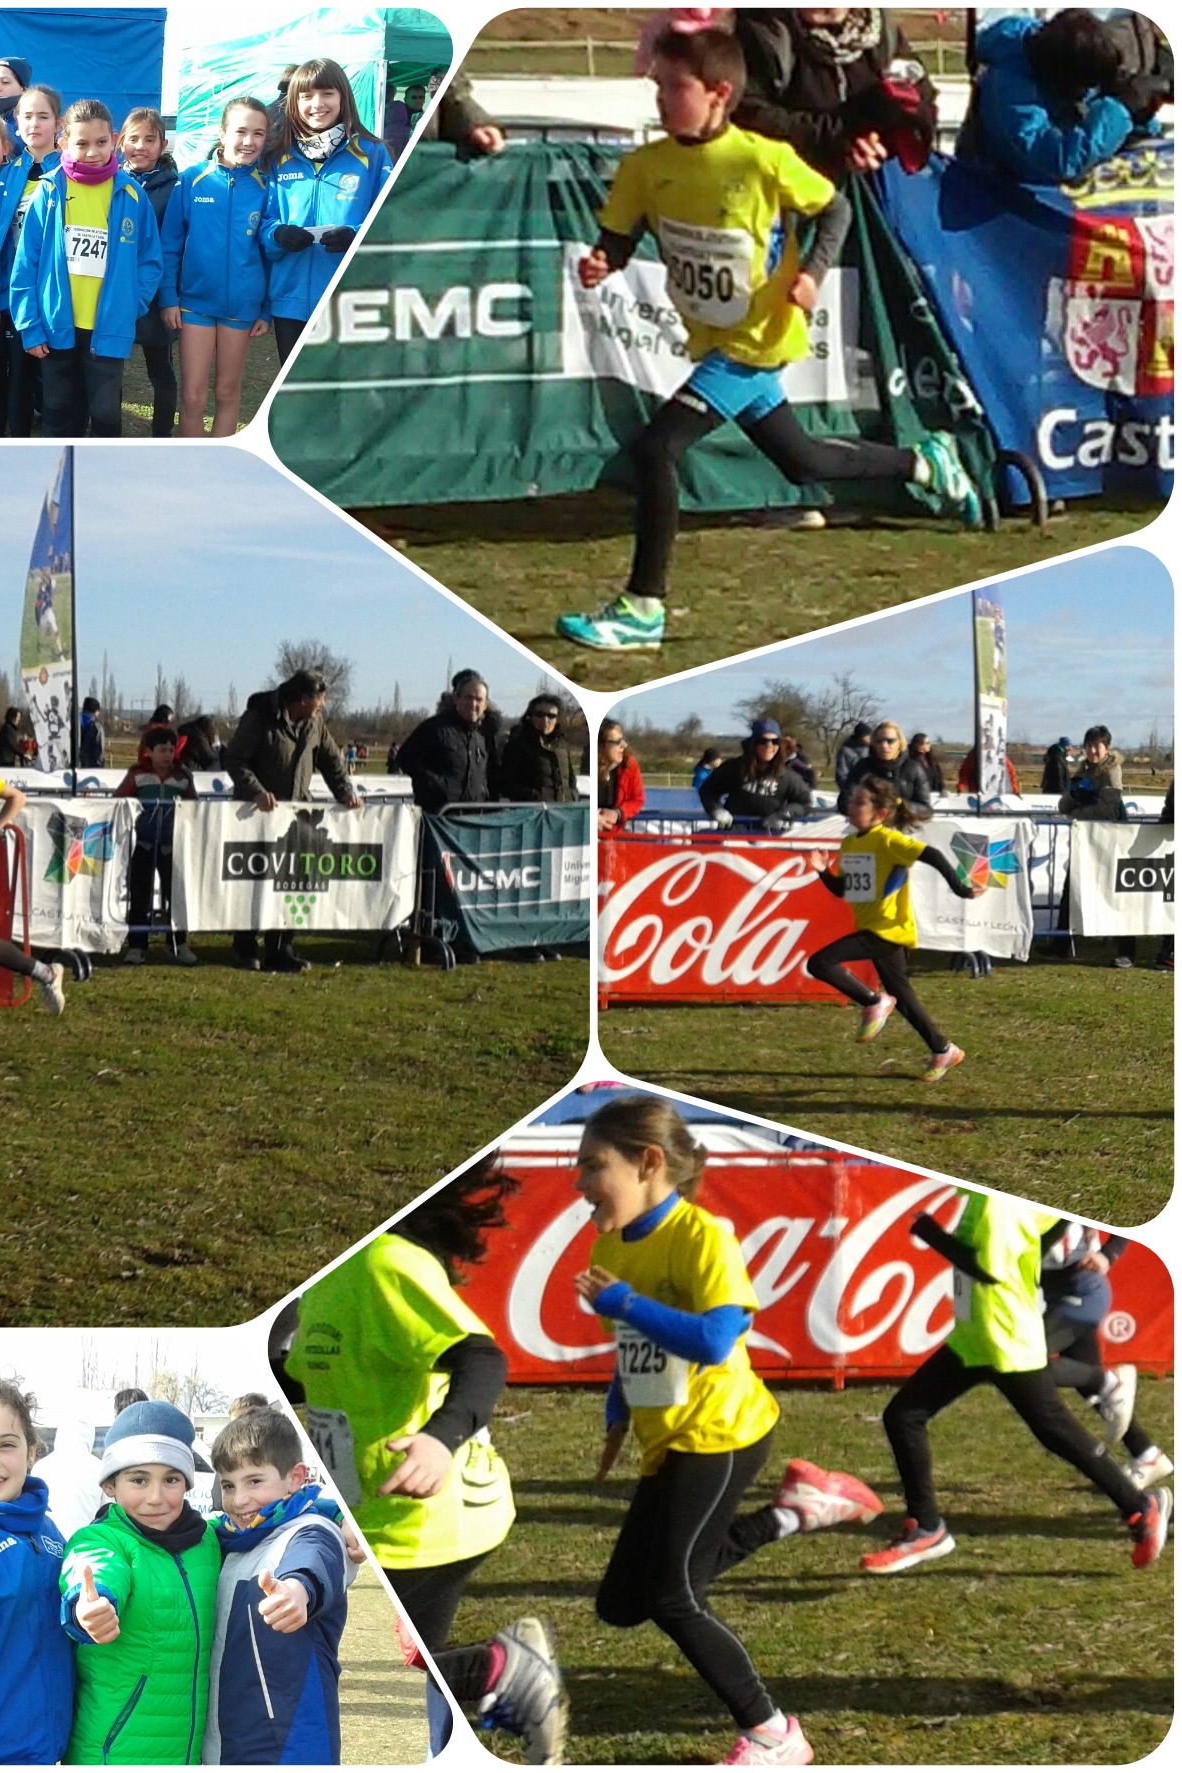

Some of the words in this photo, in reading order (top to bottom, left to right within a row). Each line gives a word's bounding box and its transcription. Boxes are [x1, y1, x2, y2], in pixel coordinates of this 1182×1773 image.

[72, 236, 107, 259] 7247
[275, 881, 327, 891] BODEGAS
[457, 865, 542, 892] UEMC
[618, 1341, 668, 1374] 7225
